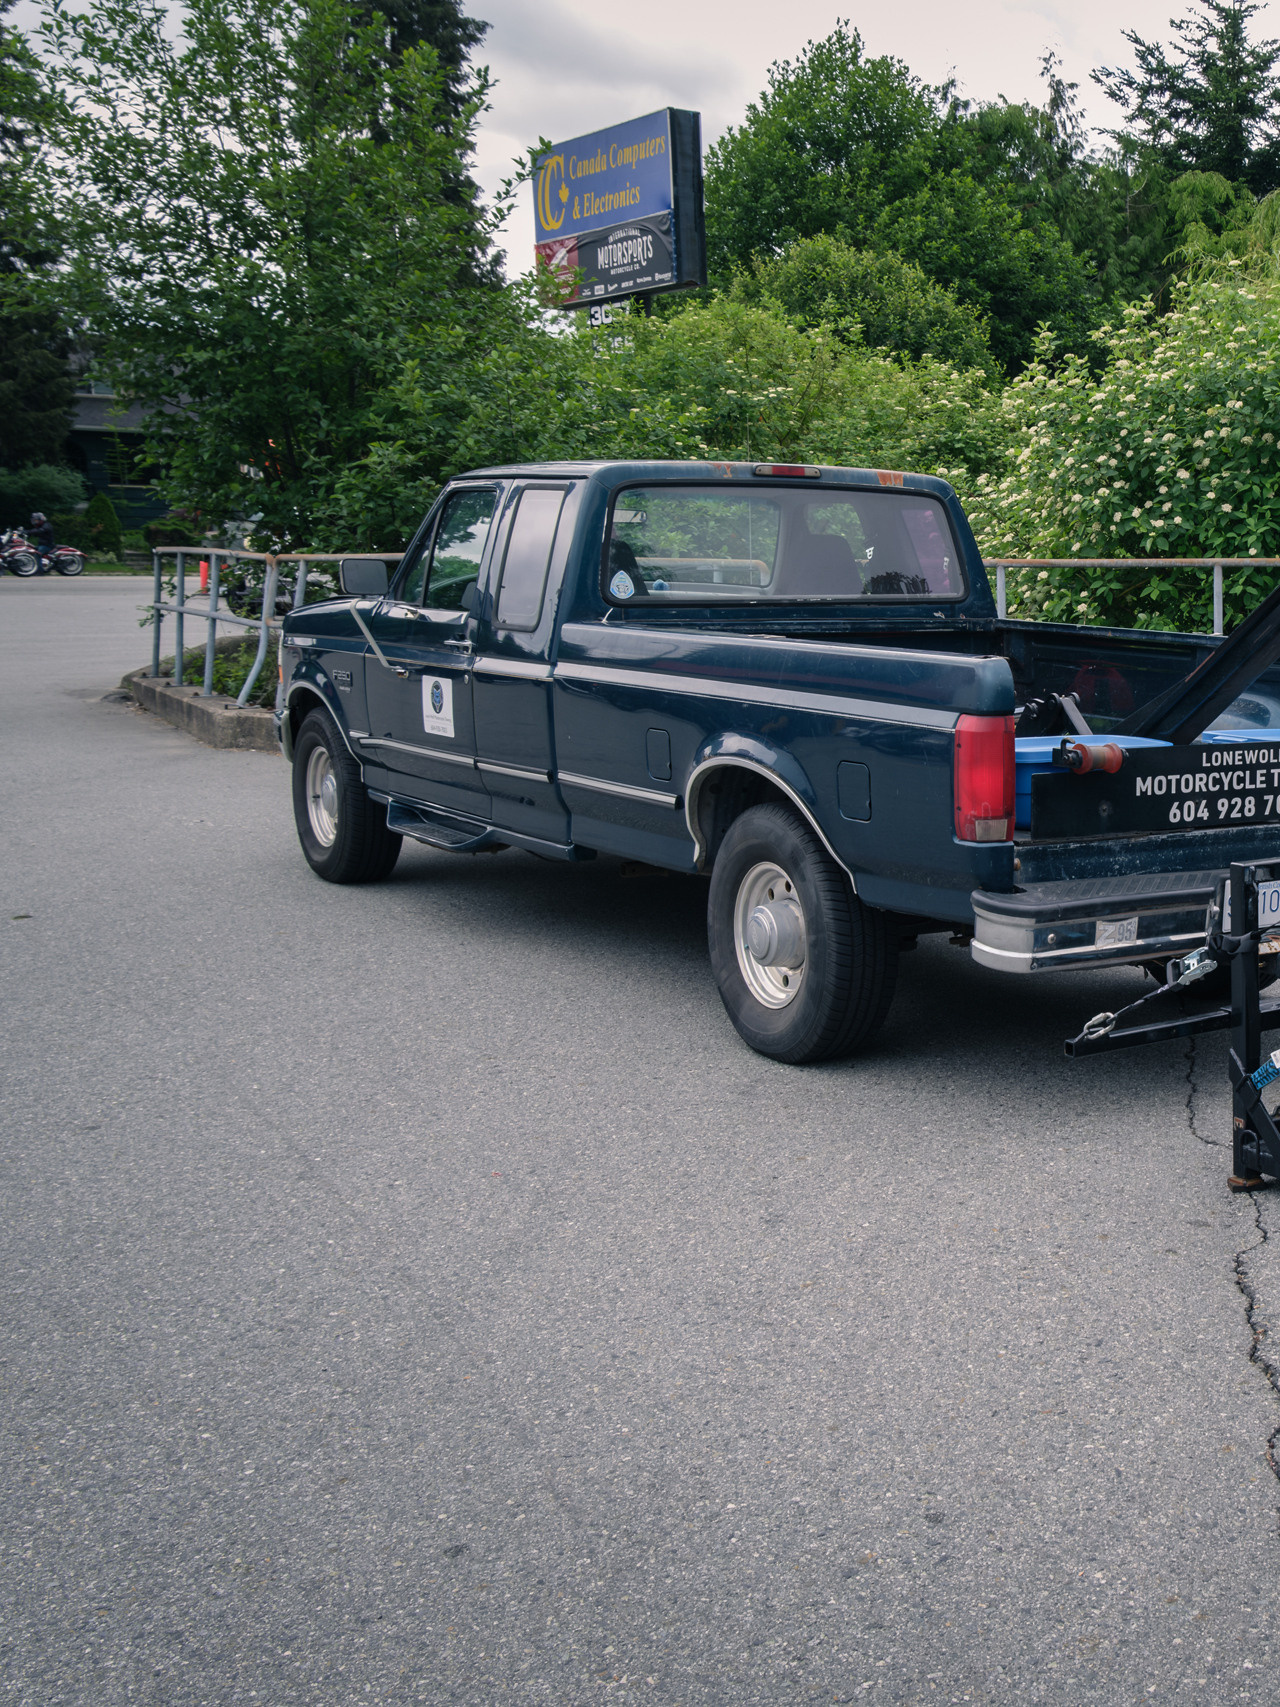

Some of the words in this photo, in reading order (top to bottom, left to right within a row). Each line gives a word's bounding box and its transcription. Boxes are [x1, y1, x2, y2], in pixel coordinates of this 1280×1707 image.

[569, 148, 607, 180] Canada
[609, 135, 666, 169] Computers
[572, 195, 581, 220] &
[583, 182, 640, 217] Electronics
[608, 228, 641, 244] INTERNATIONAL
[597, 235, 653, 269] MOTORSPORTS
[1135, 769, 1267, 797] MOTORCYCLE
[1168, 799, 1209, 823] 604
[1217, 796, 1256, 819] 928
